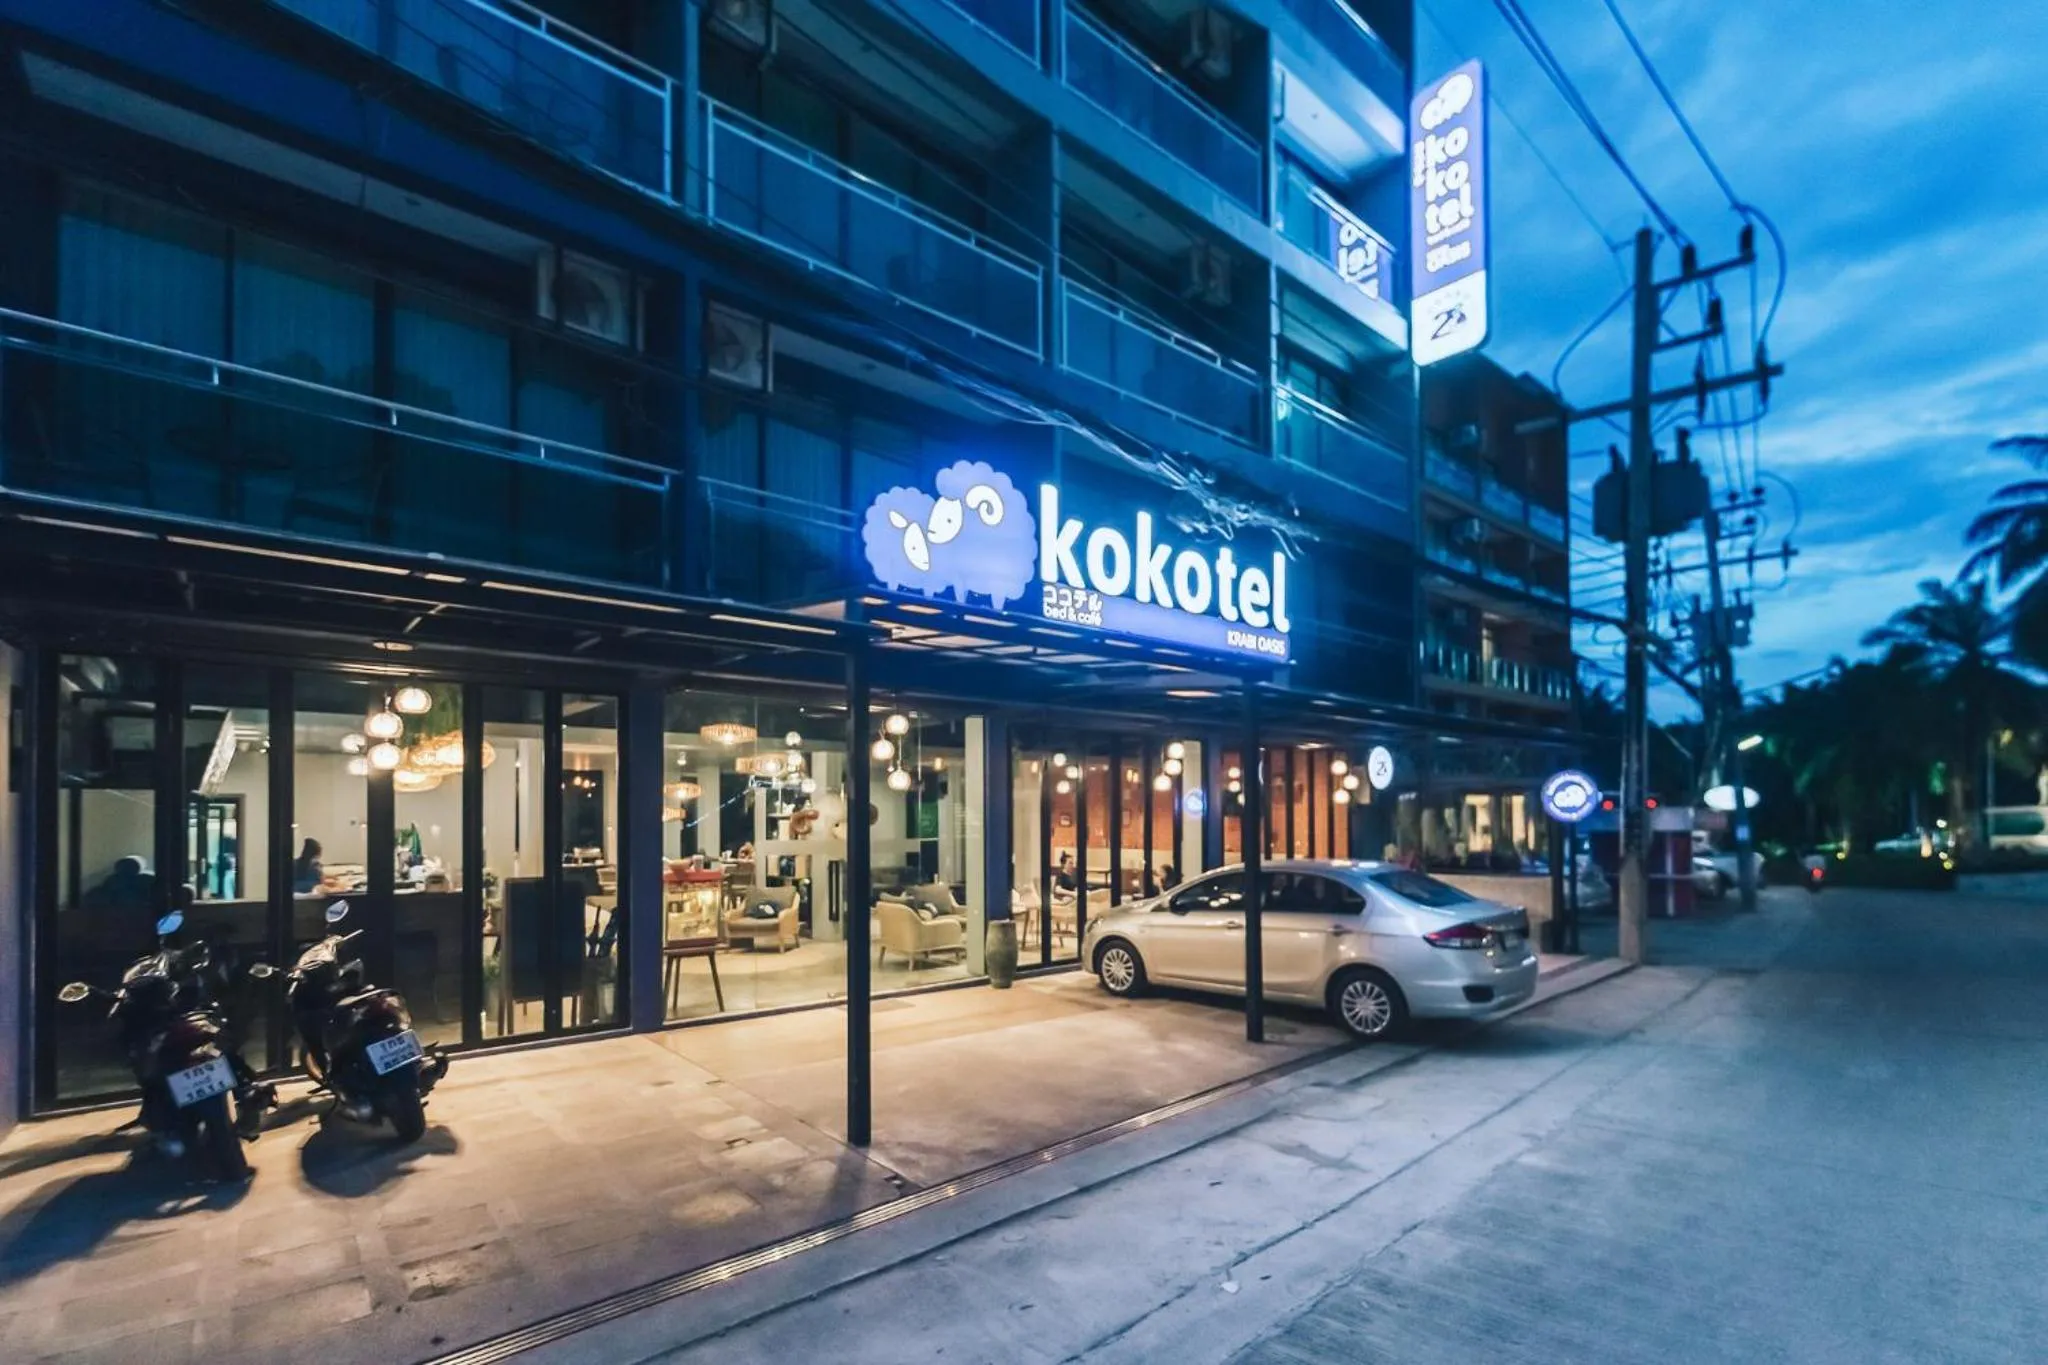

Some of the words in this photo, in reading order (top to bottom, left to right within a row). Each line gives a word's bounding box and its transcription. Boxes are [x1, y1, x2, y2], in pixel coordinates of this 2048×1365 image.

[1040, 484, 1291, 632] kokotel
[1043, 585, 1103, 611] ココテル
[1043, 603, 1067, 619] bed
[1227, 630, 1257, 649] KRABI
[1258, 636, 1286, 656] OASIS
